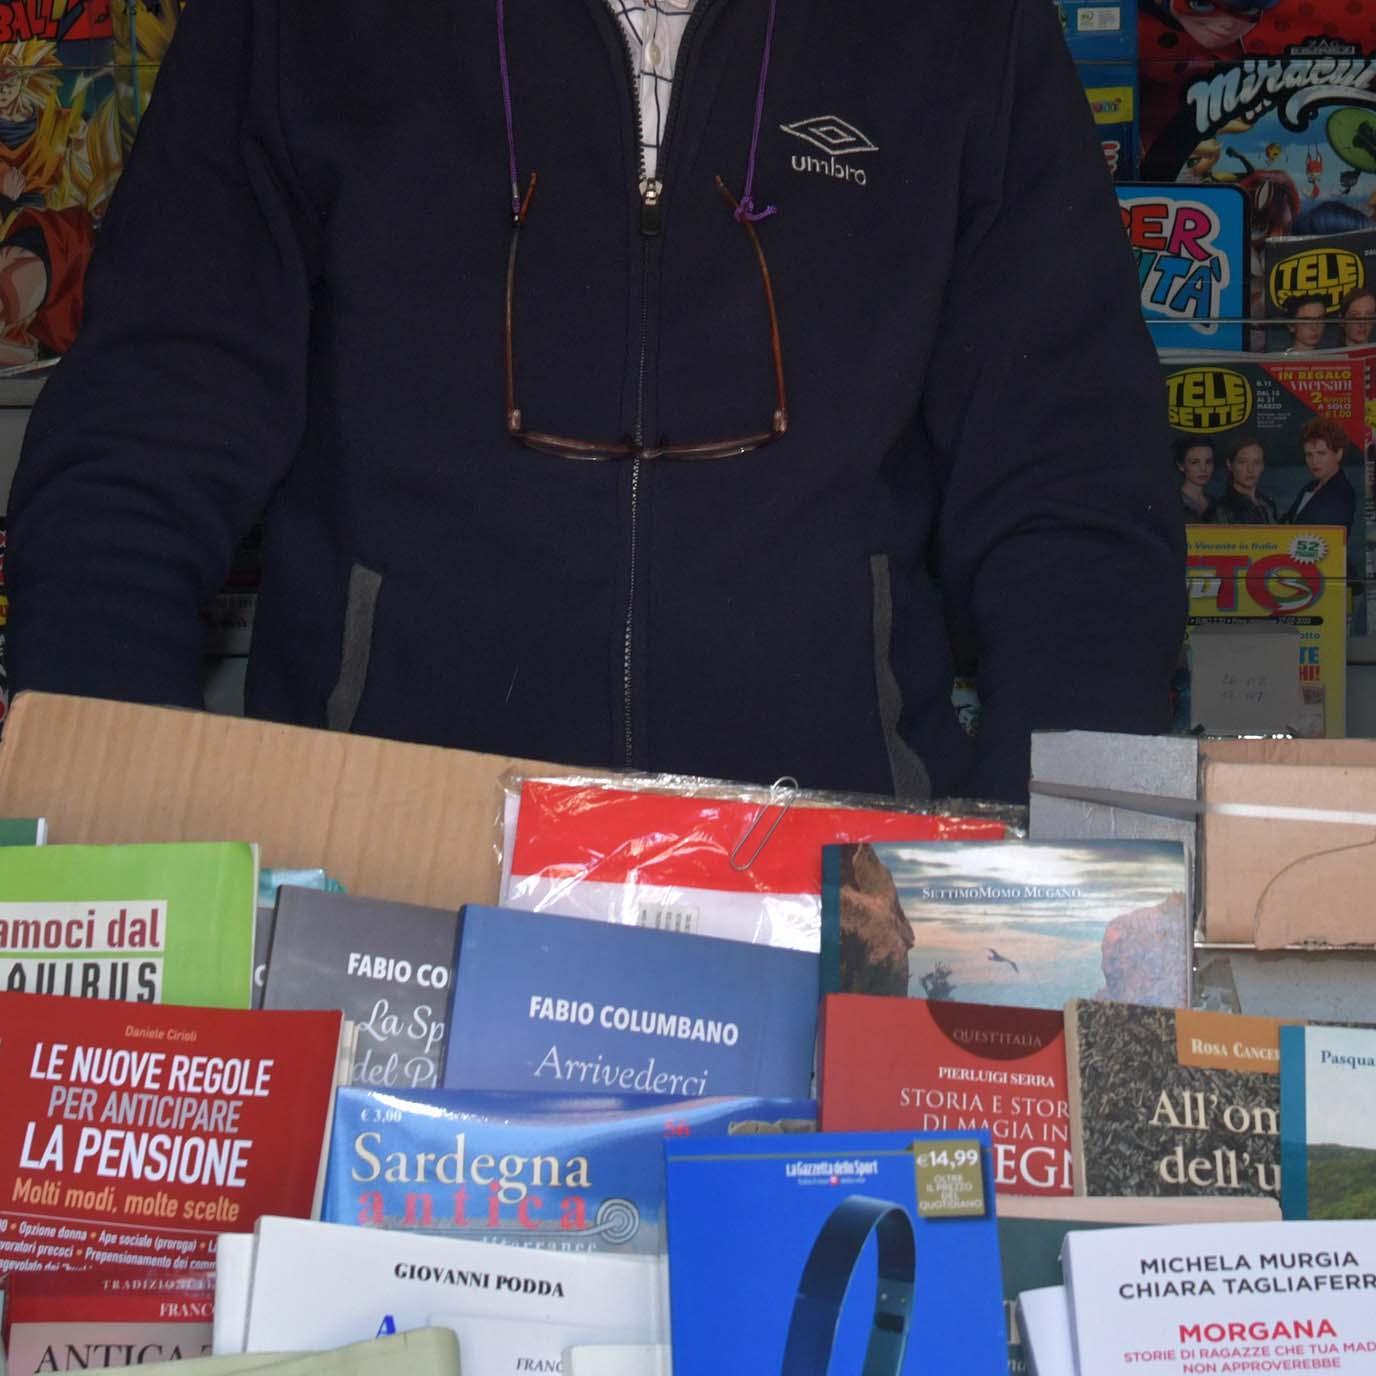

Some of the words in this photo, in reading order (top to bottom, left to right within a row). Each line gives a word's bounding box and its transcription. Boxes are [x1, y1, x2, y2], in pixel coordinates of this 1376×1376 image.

[791, 155, 867, 187] umbro
[1165, 372, 1244, 406] TELE
[106, 908, 160, 947] dal
[529, 995, 595, 1025] FABIO
[600, 1006, 739, 1046] COLUMBANO
[29, 1042, 69, 1081] LE
[69, 1045, 165, 1091] NUOVE
[168, 1054, 274, 1098] REGOLE
[534, 1045, 708, 1096] Arrivederci
[47, 1086, 98, 1122] PER
[99, 1091, 244, 1134] ANTICIPARE
[19, 1121, 64, 1172] LA
[73, 1126, 253, 1188] PENSIONE
[351, 1132, 593, 1204] Sardegna
[12, 1177, 61, 1206] Molti
[64, 1183, 117, 1214] modi,
[124, 1192, 177, 1219] molte
[182, 1198, 240, 1223] scelte
[356, 1182, 591, 1230] antica
[393, 1261, 490, 1291] GIOVANNI
[494, 1275, 565, 1299] PODDA
[1140, 1254, 1251, 1276] MICHELA
[1259, 1251, 1360, 1271] MURGIA
[1118, 1279, 1216, 1300] CHIARA
[1178, 1318, 1338, 1344] MORGANA
